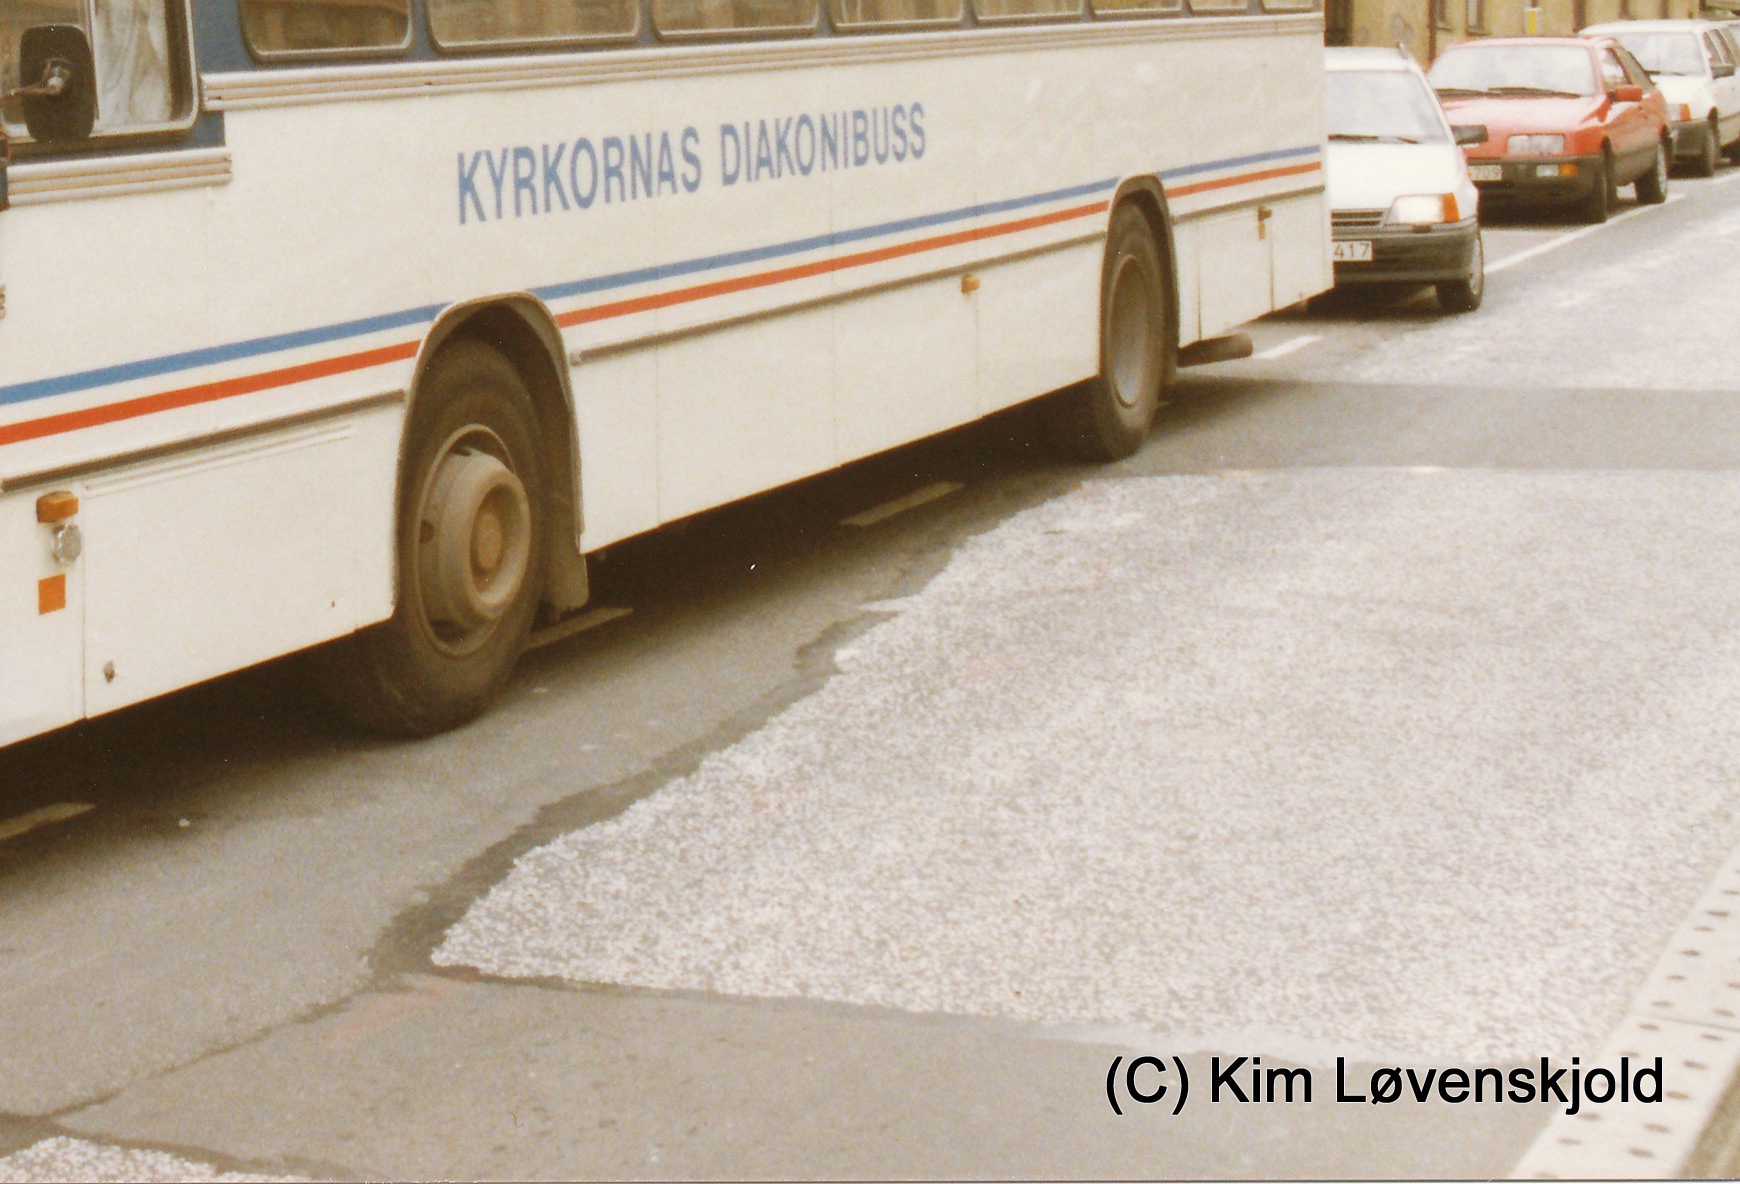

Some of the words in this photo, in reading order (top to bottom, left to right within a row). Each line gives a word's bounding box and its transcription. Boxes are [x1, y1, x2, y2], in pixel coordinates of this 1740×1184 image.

[458, 126, 702, 225] KYRKORNAS
[720, 102, 927, 187] DIAKONIBUSS
[1333, 243, 1371, 259] 417
